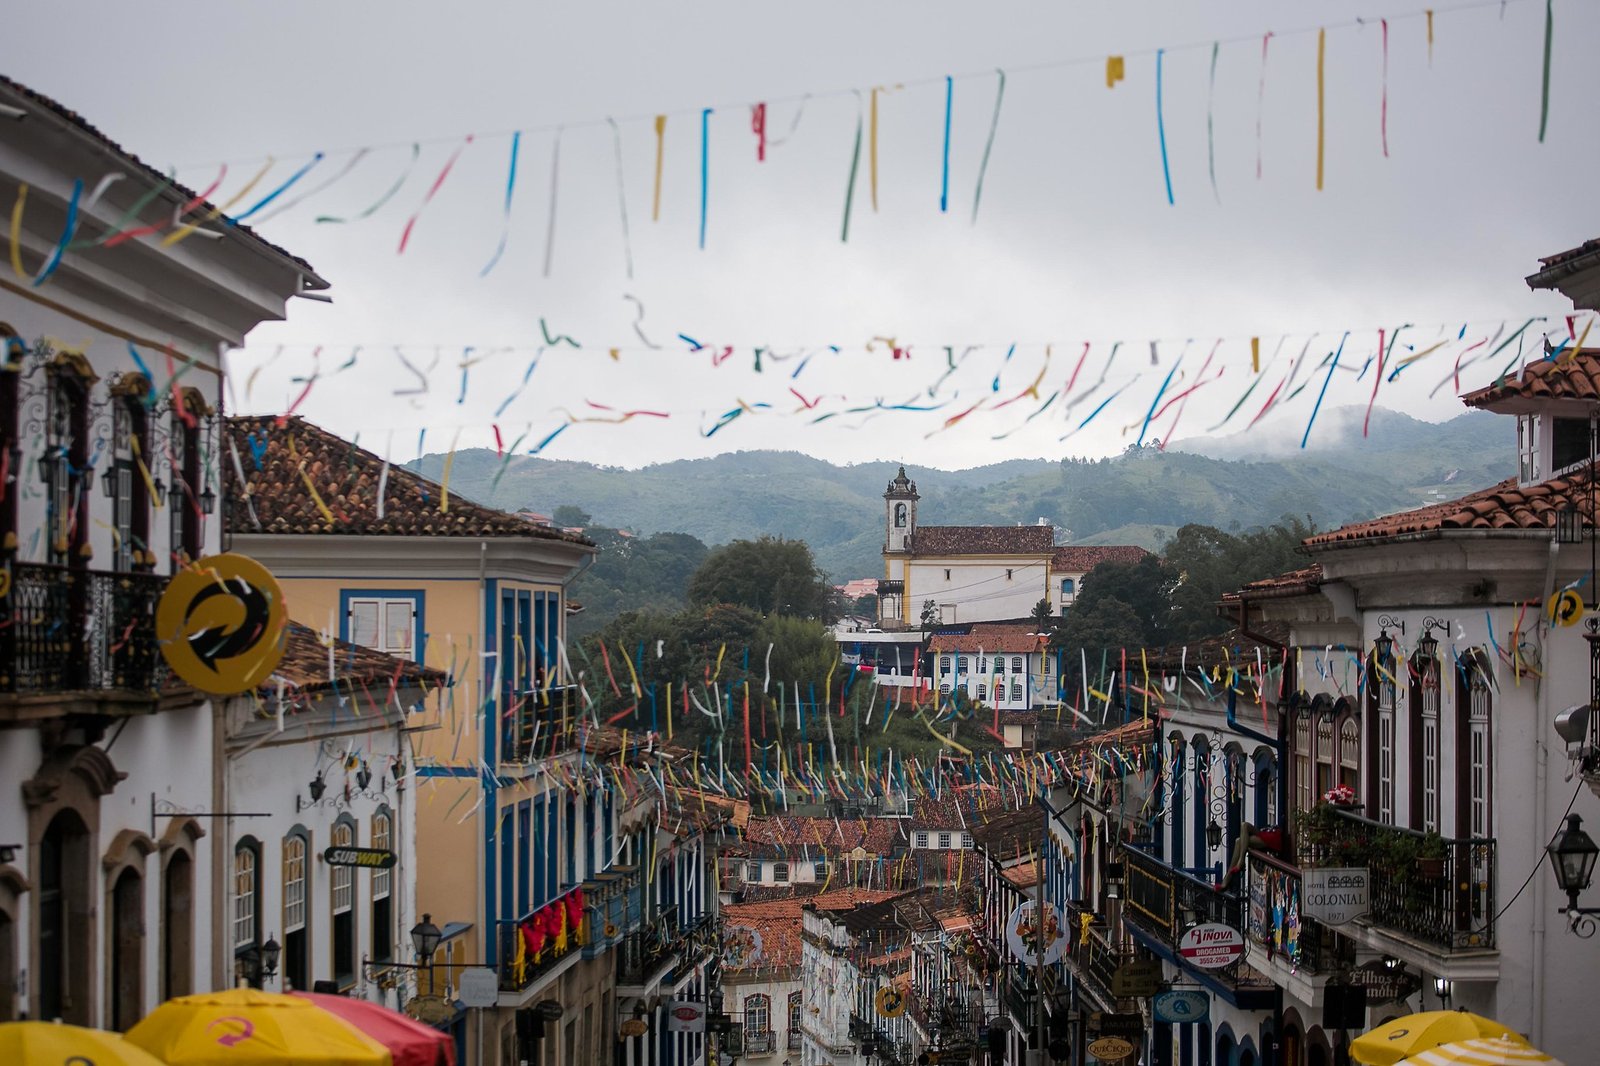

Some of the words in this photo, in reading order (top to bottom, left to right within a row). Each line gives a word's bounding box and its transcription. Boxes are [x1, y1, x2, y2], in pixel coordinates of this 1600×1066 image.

[329, 849, 391, 865] SUBWAY
[1307, 894, 1365, 906] COLONIAL
[1328, 912, 1345, 920] 1973
[1202, 931, 1233, 941] INOVA
[1196, 947, 1231, 956] DROGAMED
[1199, 956, 1230, 964] 3552-2503
[1349, 970, 1392, 985] Filhos
[1397, 976, 1408, 984] de
